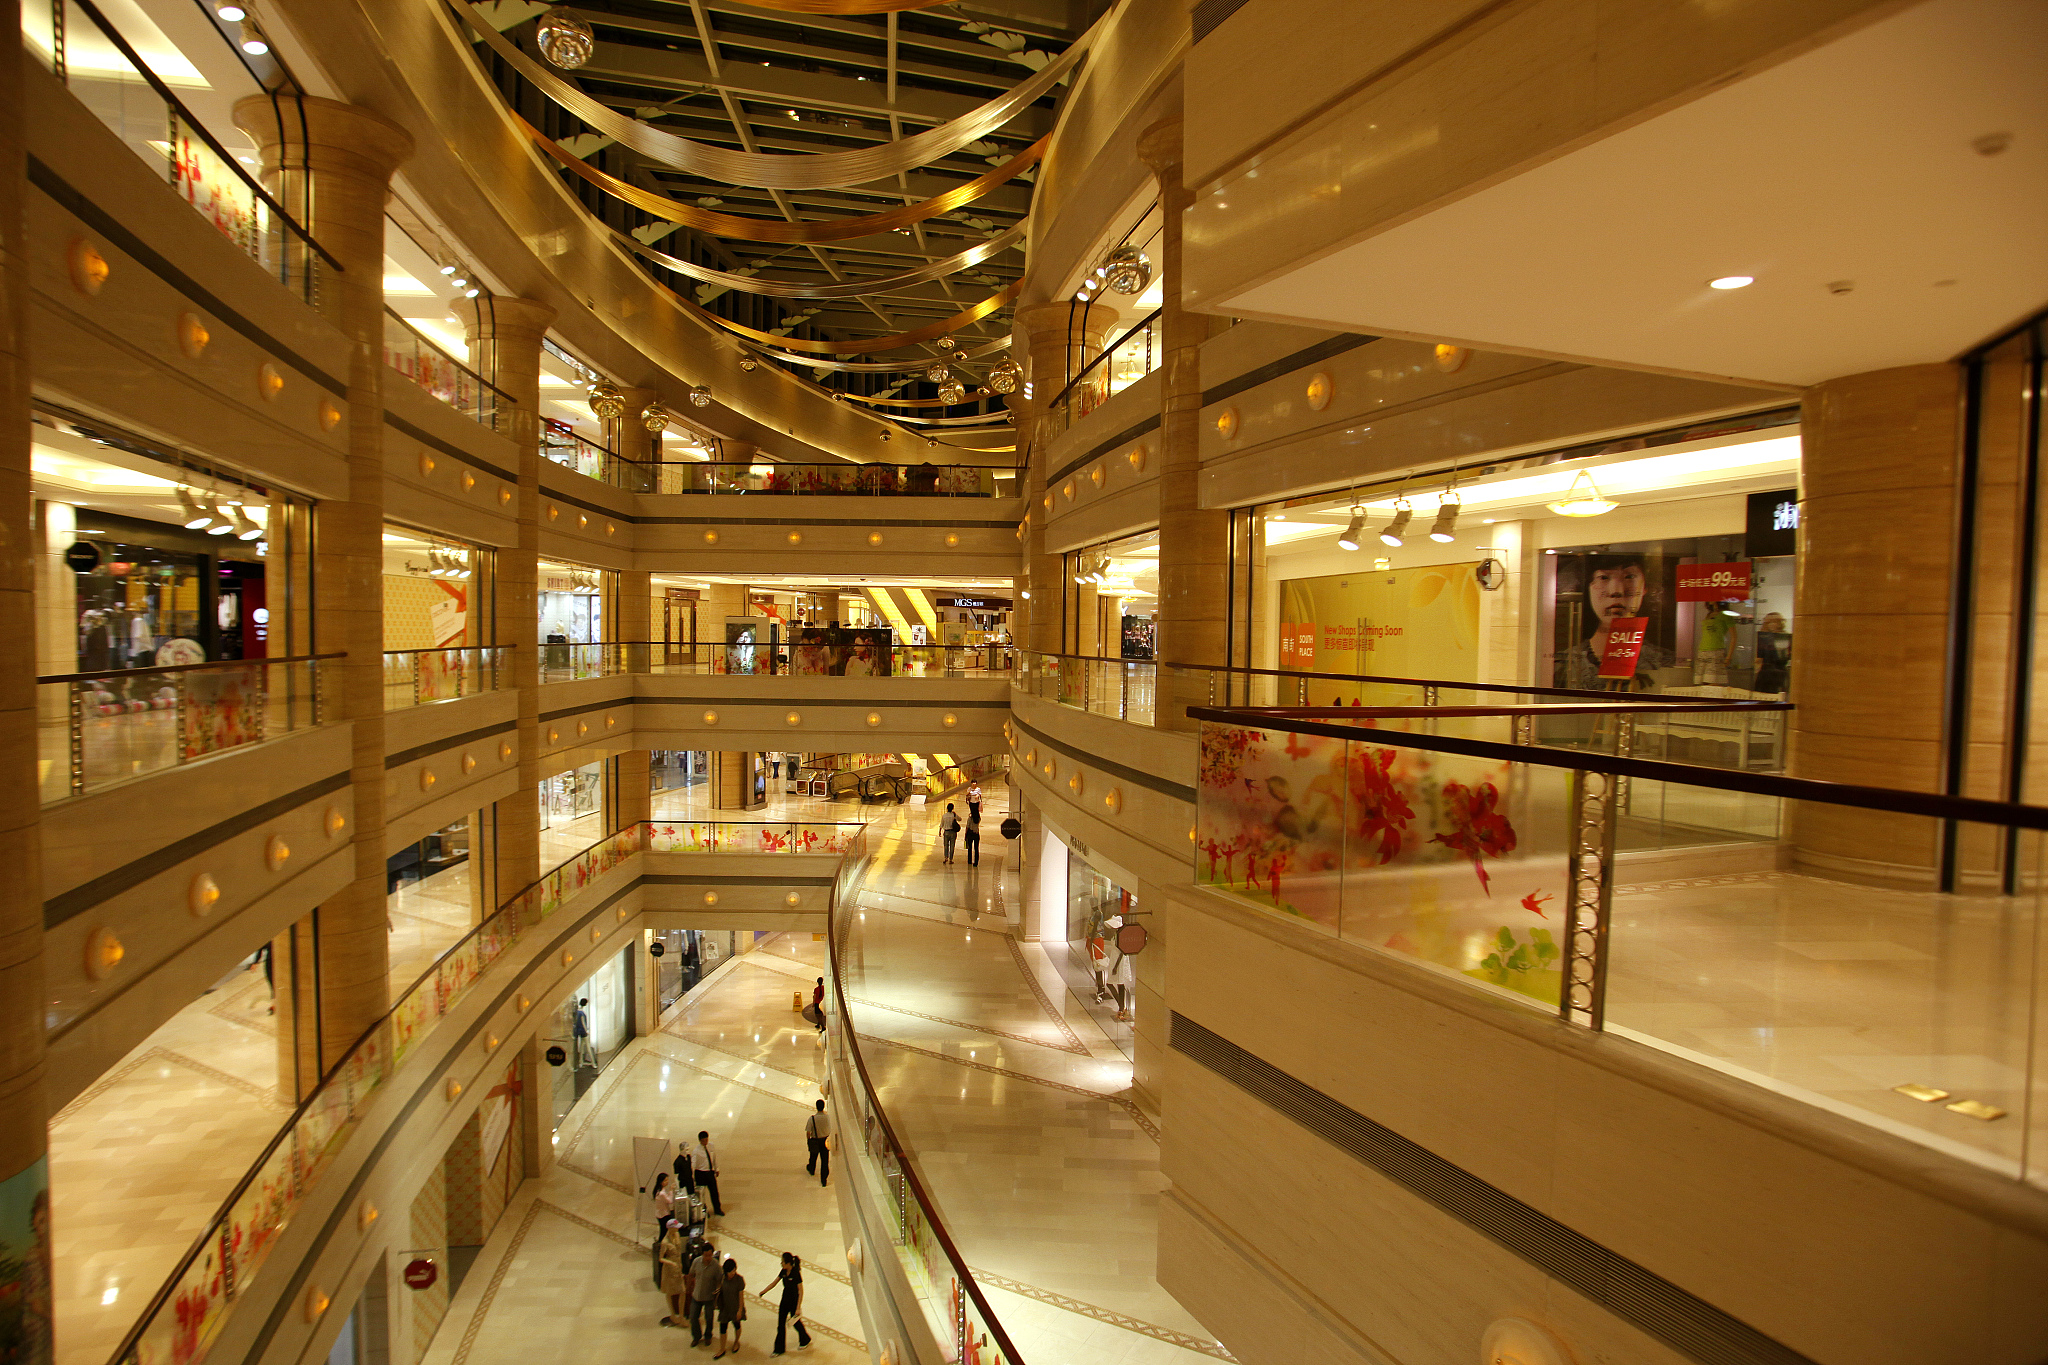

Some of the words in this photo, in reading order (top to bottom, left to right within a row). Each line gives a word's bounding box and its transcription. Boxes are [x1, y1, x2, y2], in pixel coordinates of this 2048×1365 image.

[954, 598, 972, 607] MGS
[1324, 625, 1337, 635] New
[1338, 625, 1356, 637] Shops
[1385, 625, 1403, 636] Soon
[1299, 635, 1314, 644] SOUTH
[1609, 631, 1642, 643] SALE
[1299, 647, 1313, 657] PLACE
